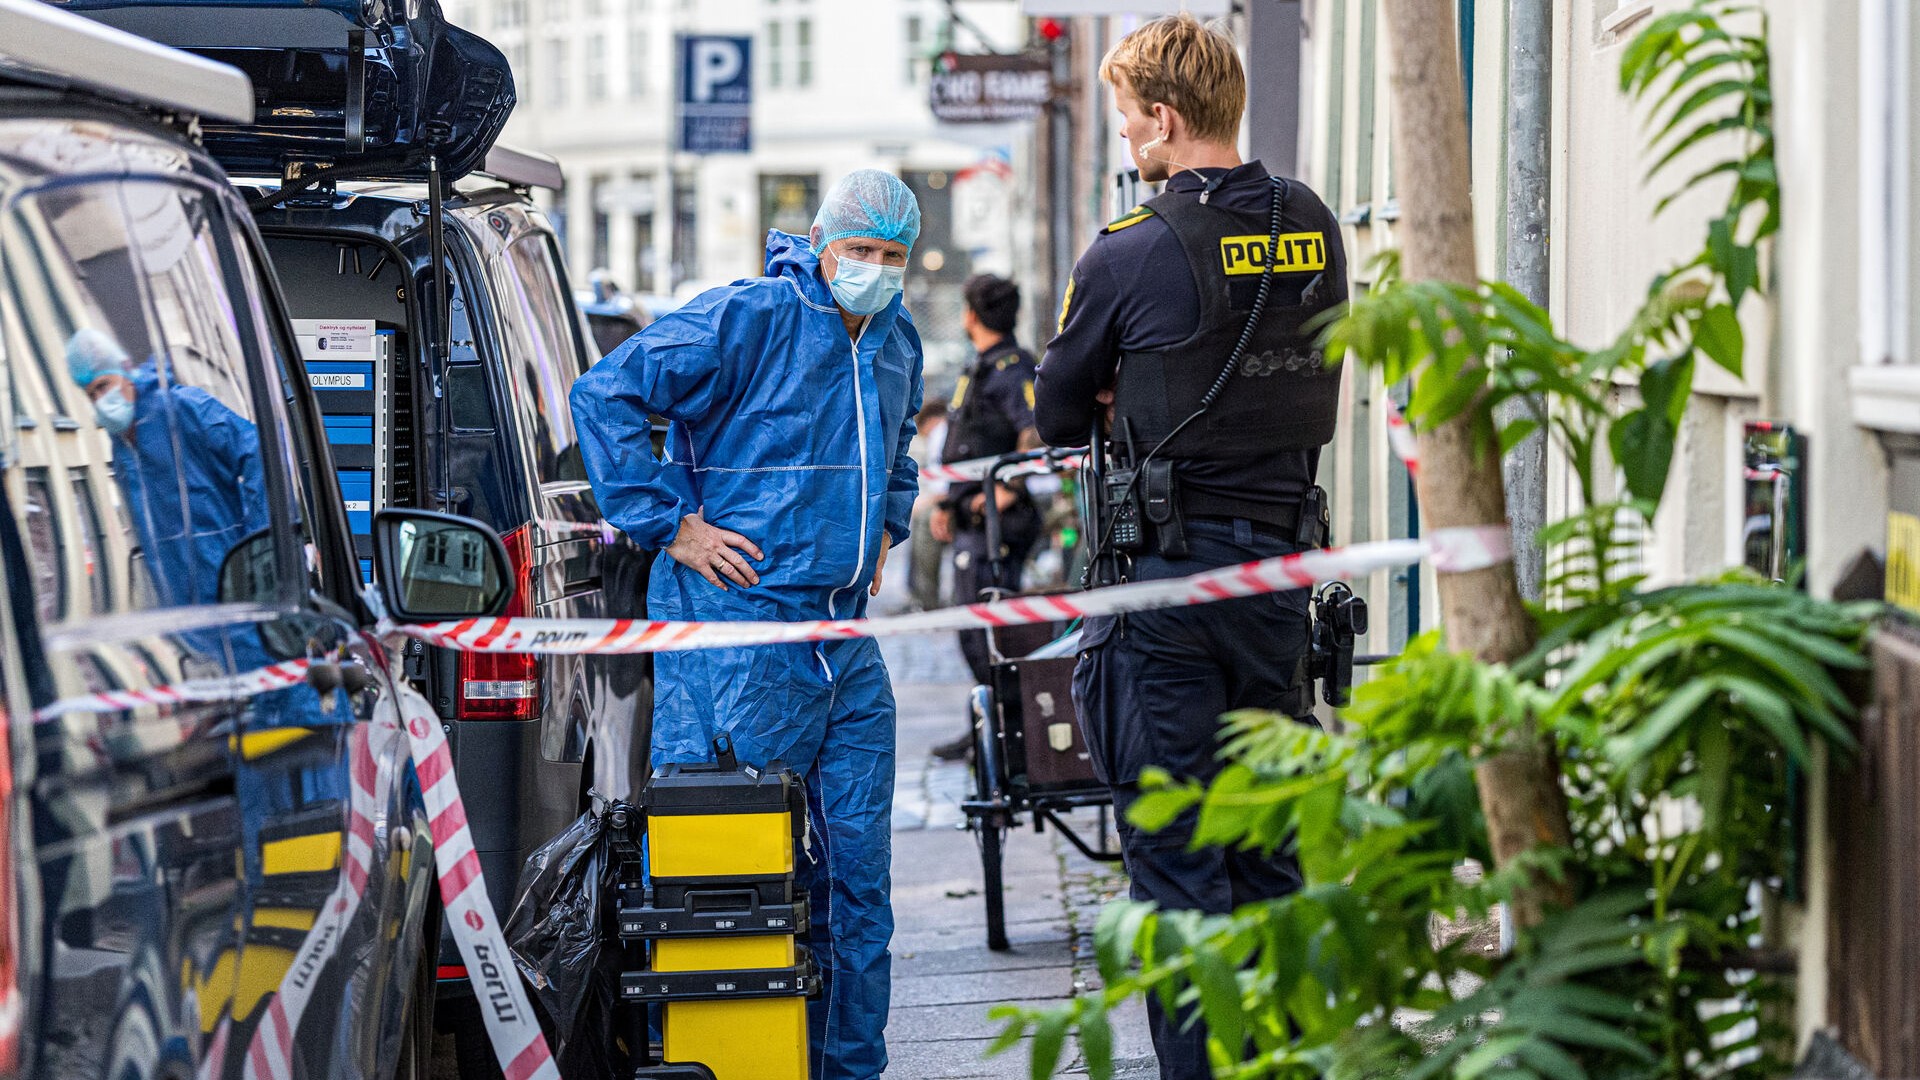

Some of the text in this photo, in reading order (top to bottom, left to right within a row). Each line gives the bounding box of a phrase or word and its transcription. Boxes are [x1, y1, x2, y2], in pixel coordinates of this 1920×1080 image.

[692, 40, 743, 101] P
[1223, 238, 1324, 268] POLITI
[312, 375, 352, 386] OLYMPUS
